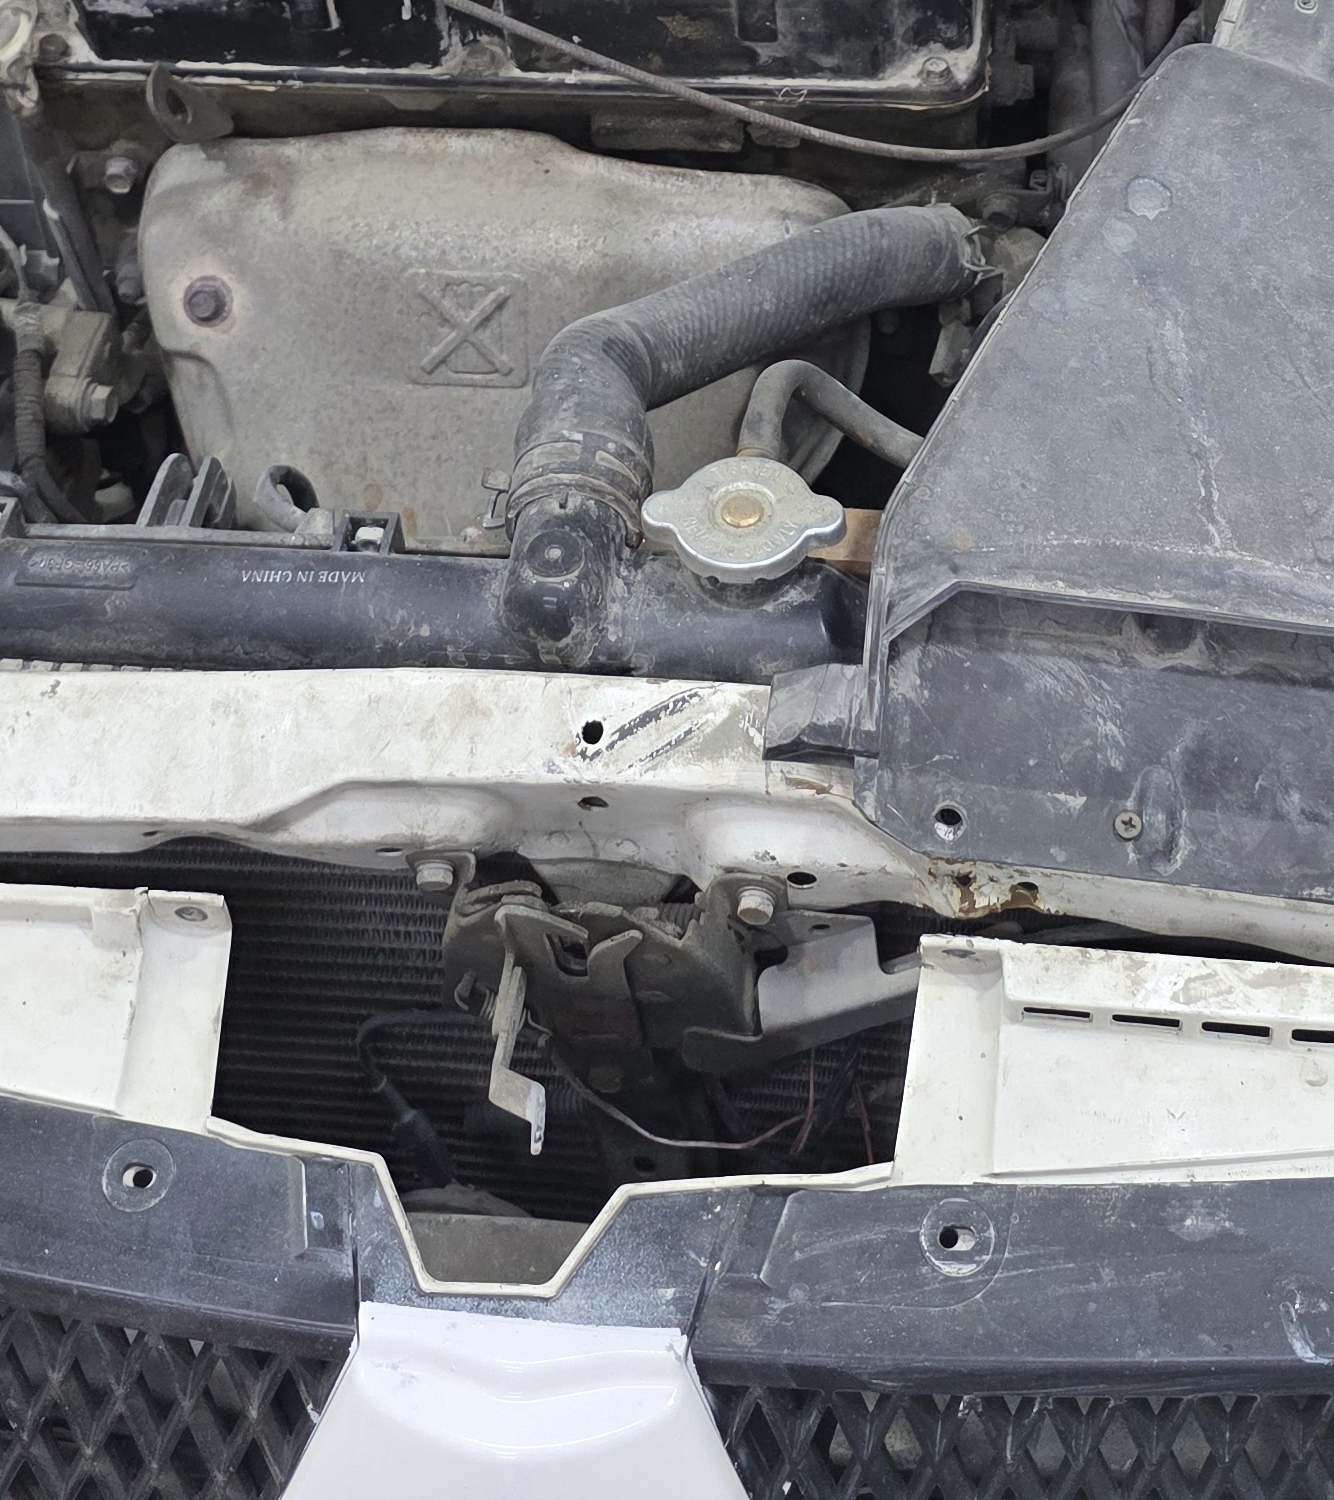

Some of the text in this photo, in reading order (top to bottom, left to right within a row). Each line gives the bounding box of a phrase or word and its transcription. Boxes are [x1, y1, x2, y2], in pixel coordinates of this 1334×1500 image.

[240, 569, 367, 584] MADE IN CHINA
